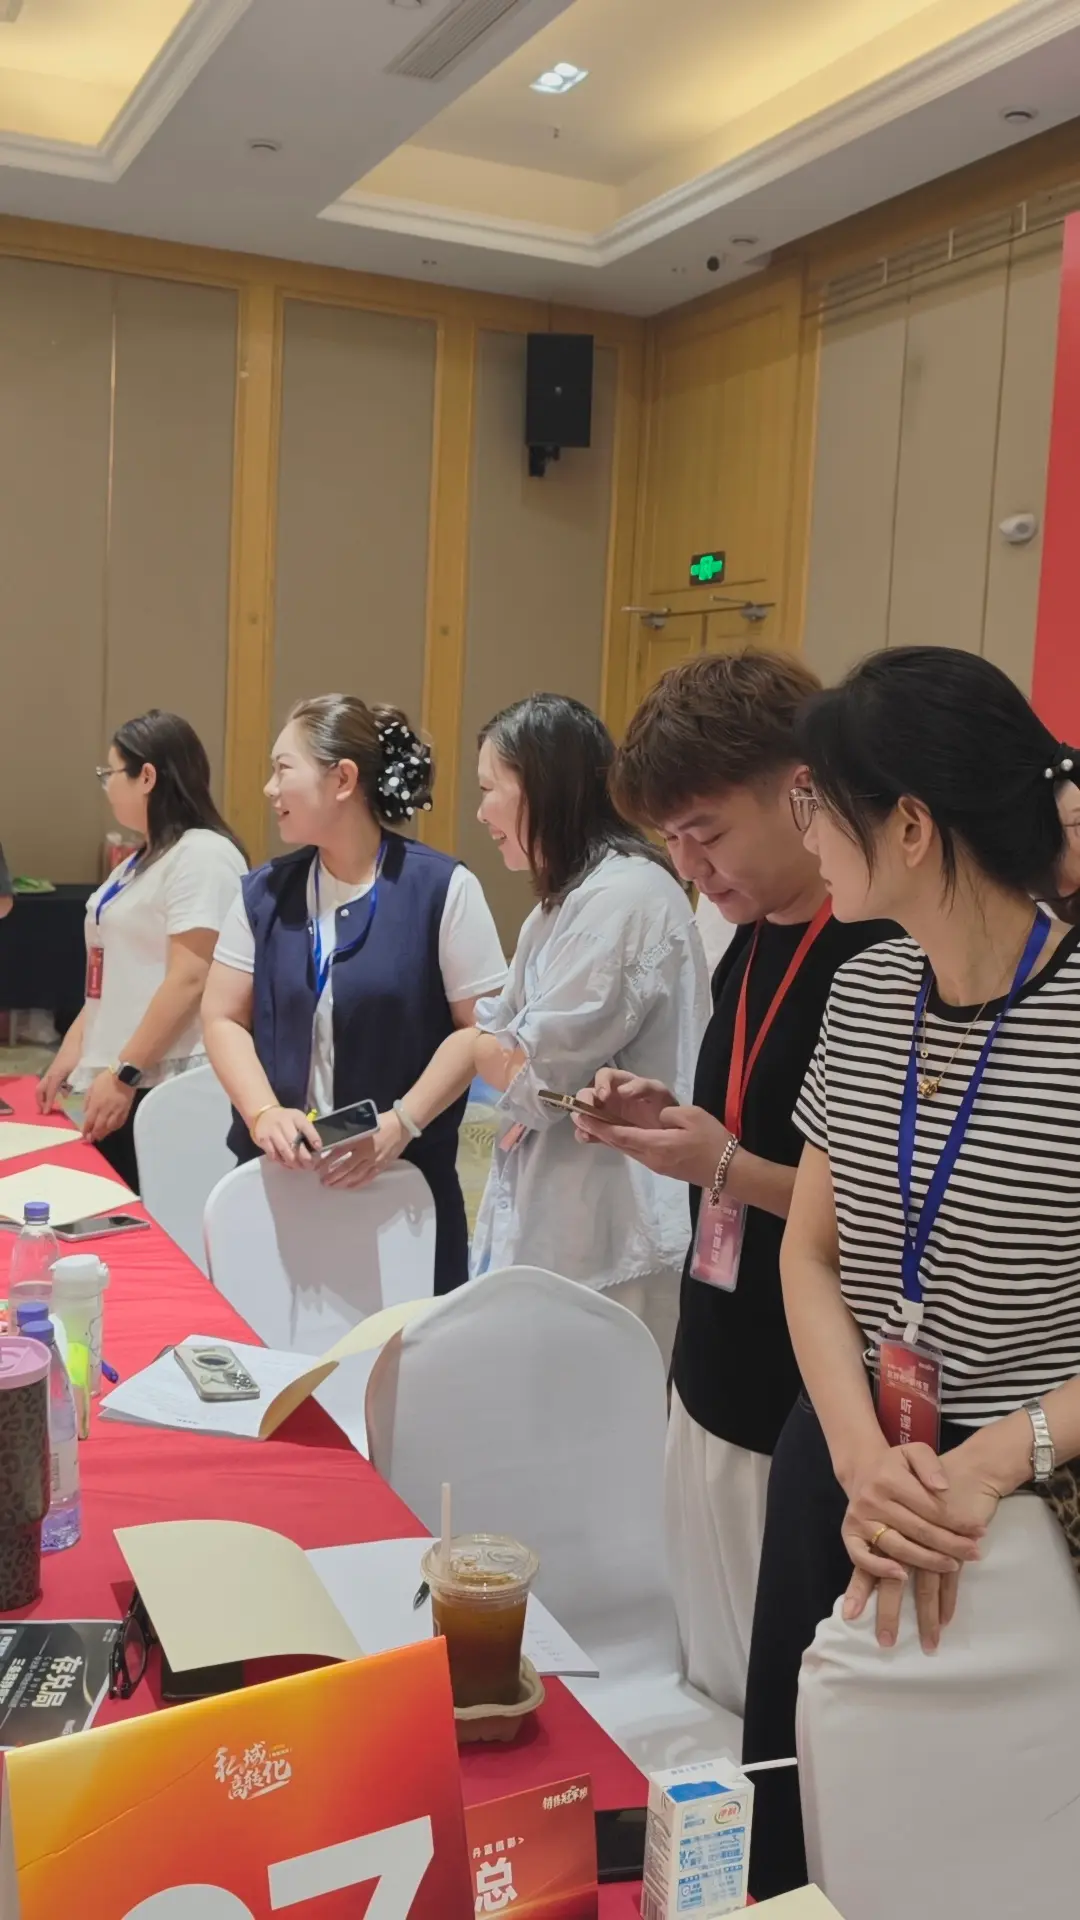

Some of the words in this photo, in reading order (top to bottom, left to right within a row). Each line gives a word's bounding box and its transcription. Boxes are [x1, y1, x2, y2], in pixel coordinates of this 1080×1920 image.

[31, 1655, 83, 1708] 存兑局
[120, 1815, 435, 1920] 7
[474, 1857, 518, 1912] 总
